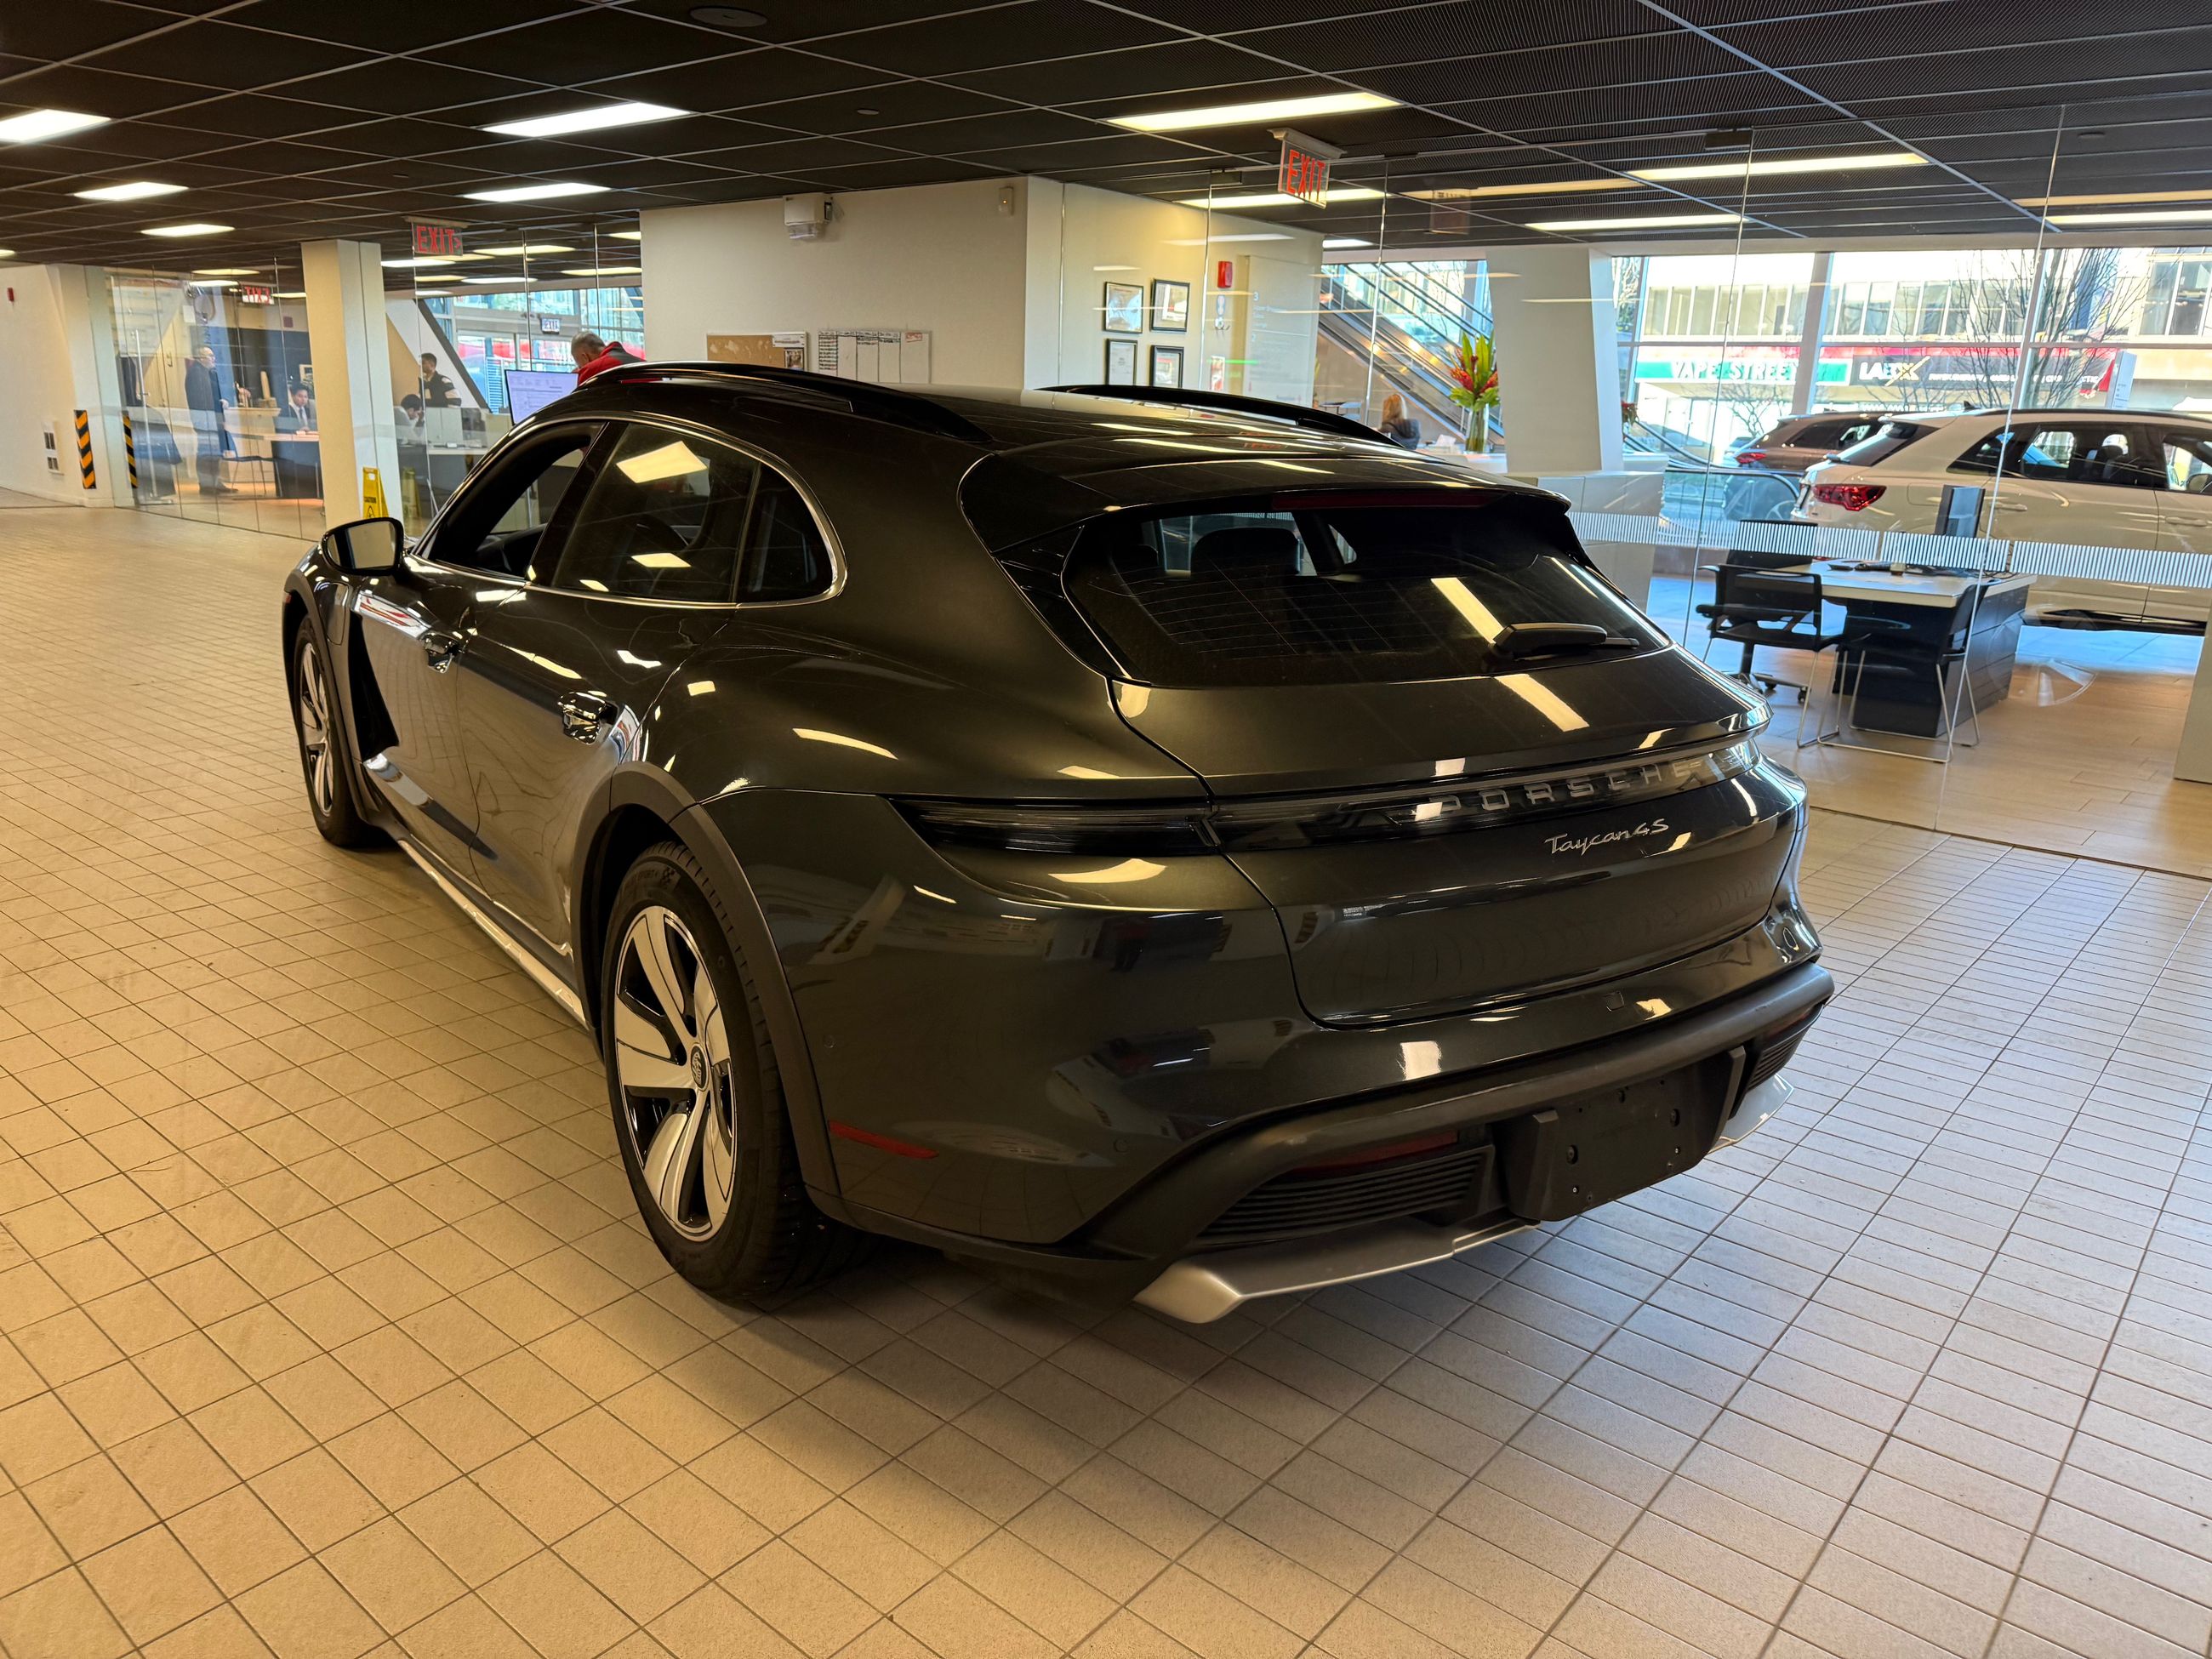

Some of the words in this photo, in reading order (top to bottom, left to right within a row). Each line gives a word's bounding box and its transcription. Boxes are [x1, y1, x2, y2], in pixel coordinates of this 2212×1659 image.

[1287, 150, 1326, 202] EXIT
[416, 225, 455, 254] EXIT
[1670, 361, 1722, 381] VAPE
[1728, 360, 1799, 381] STREET
[1429, 761, 1702, 812] PORSCHE
